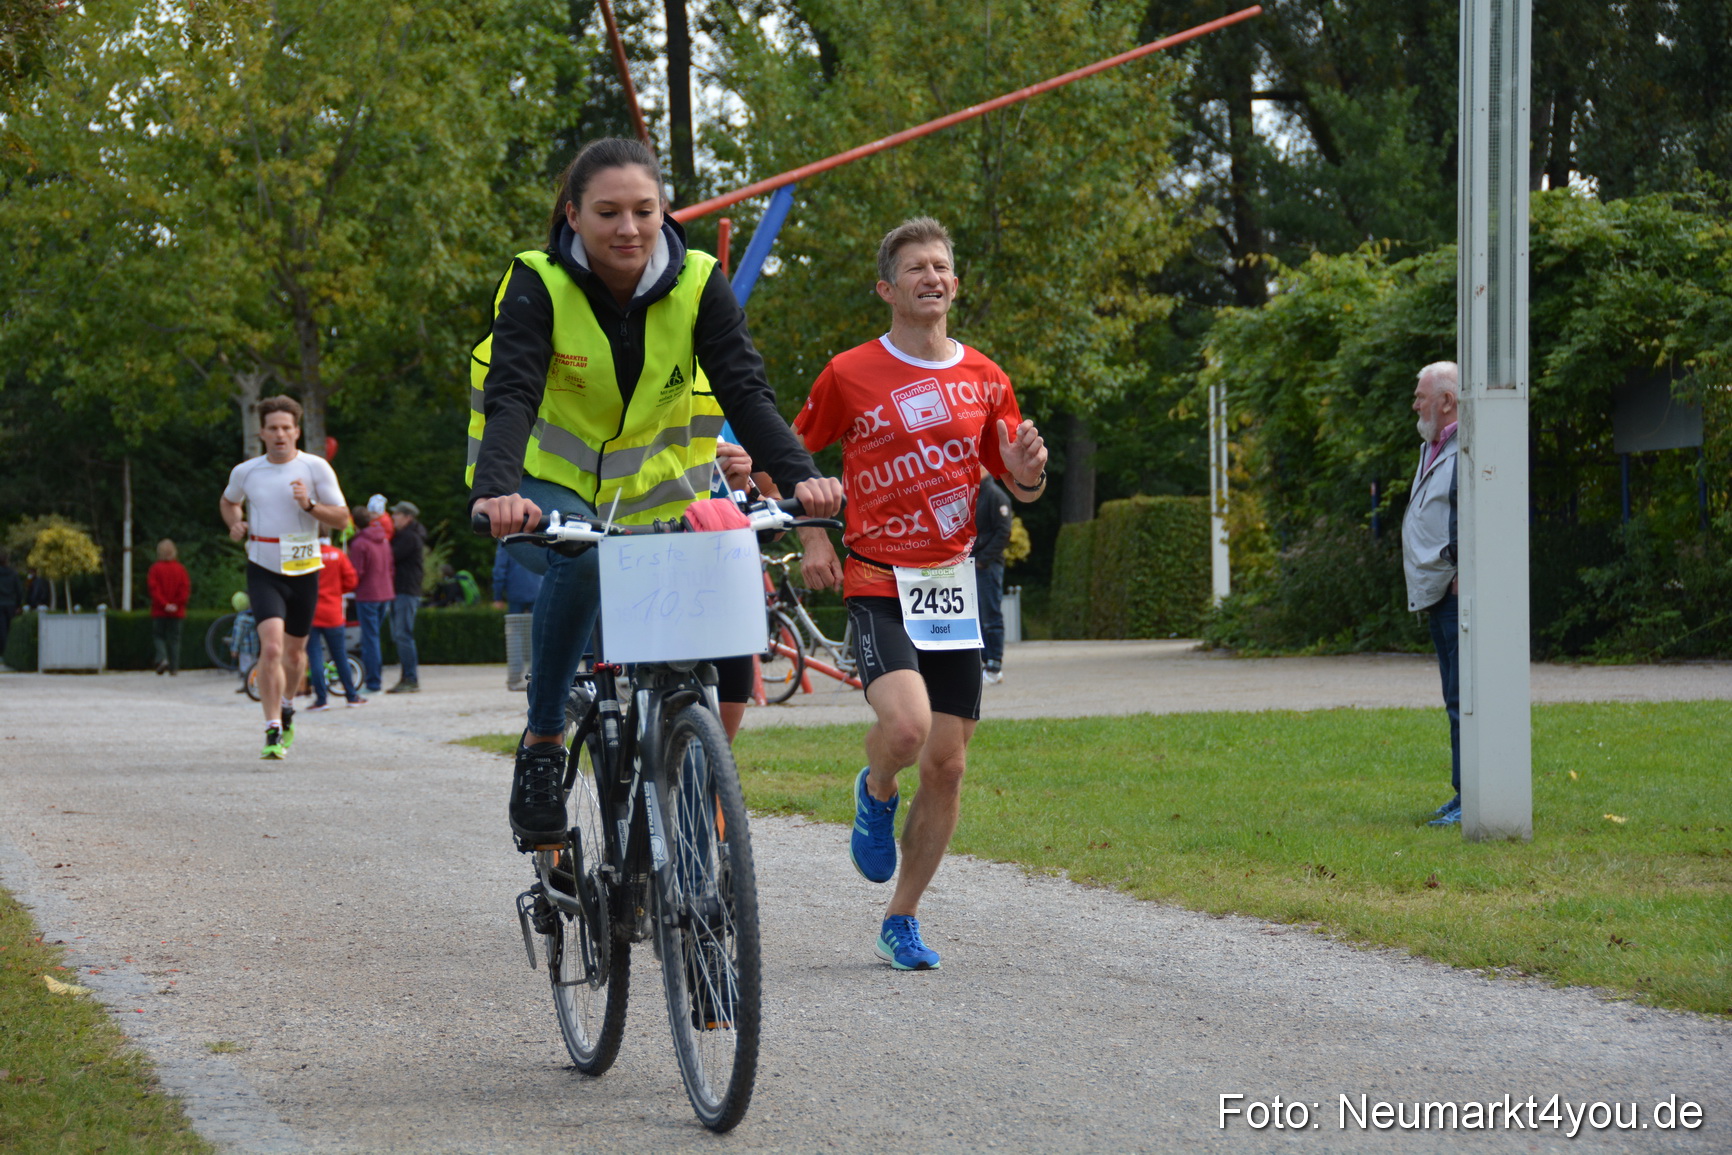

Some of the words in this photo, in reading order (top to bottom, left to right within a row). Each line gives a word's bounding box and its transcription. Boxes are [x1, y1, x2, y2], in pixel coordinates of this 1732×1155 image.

[895, 381, 937, 402] raumbox
[861, 432, 895, 453] outdoor
[853, 435, 979, 499] raumbox
[858, 488, 896, 513] schenken
[903, 475, 945, 495] wohnen
[932, 488, 968, 508] raumbox
[291, 543, 314, 559] 278
[617, 543, 689, 570] Erste
[705, 533, 753, 563] Frau
[885, 537, 931, 552] outdoor
[909, 587, 965, 614] 2435
[930, 623, 951, 634] Josef
